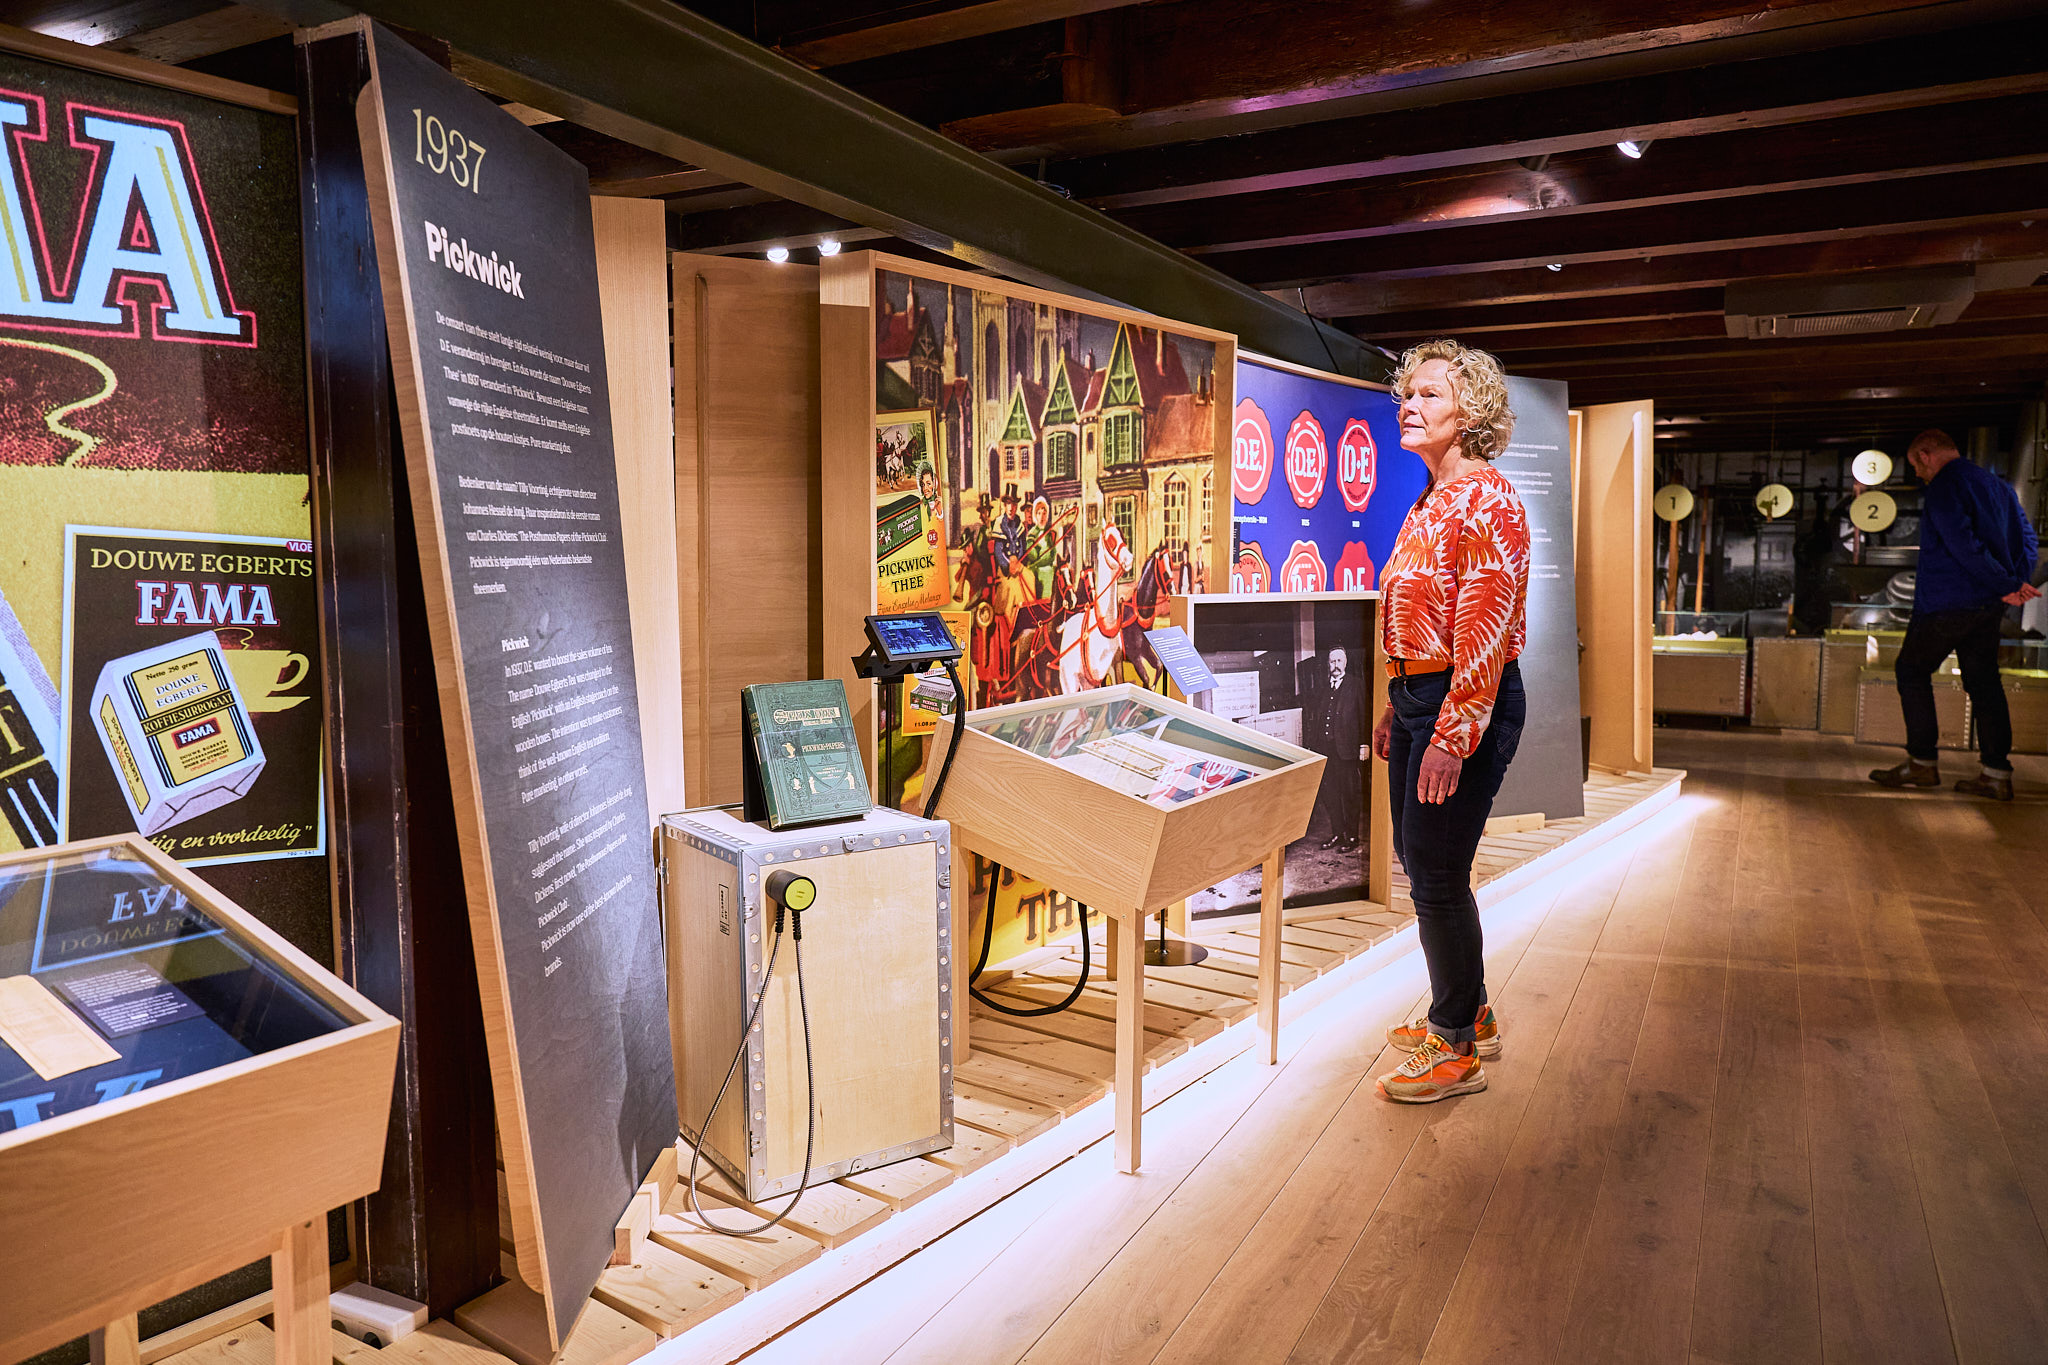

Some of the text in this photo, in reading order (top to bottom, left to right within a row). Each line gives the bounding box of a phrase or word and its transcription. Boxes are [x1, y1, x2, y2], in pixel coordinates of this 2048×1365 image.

[413, 109, 486, 194] 1937
[425, 220, 525, 300] Pickwick
[446, 317, 465, 331] omzet
[500, 334, 514, 349] lange
[523, 343, 539, 356] relatief
[539, 349, 554, 363] weinig
[451, 345, 486, 365] verandering
[490, 355, 513, 371] brengen.
[529, 369, 543, 380] wordt
[561, 377, 576, 389] 'Douwe
[576, 381, 592, 394] Egberts
[480, 379, 507, 393] veranderd
[536, 392, 553, 405] Bewust
[561, 398, 577, 411] Engelse
[447, 396, 473, 412] vanwege
[493, 404, 513, 419] Engelse
[513, 410, 541, 424] theetraditie.
[575, 424, 591, 436] Engelse
[451, 423, 480, 437] postkoets
[495, 430, 513, 443] houten
[513, 433, 531, 447] kistjes.
[541, 440, 563, 454] marketing
[1867, 462, 1877, 474] 3
[459, 475, 486, 489] Bedenker
[528, 483, 549, 497] Voorting,
[549, 486, 572, 498] echtgenote
[580, 489, 597, 499] directeur
[1670, 496, 1676, 510] 1
[1868, 504, 1879, 519] 2
[91, 548, 312, 577] DOUWE EGBERTS
[878, 555, 935, 578] PICKWICK
[474, 582, 507, 594] theemerken.
[891, 575, 924, 592] THEE
[135, 580, 280, 627] FAMA
[502, 636, 530, 651] Pickwick
[145, 660, 199, 681] Netto 250 gram
[511, 662, 525, 676] 1937,
[534, 656, 552, 670] wanted
[556, 653, 570, 665] boost
[154, 673, 201, 696] DOUWE
[154, 683, 209, 709] EGBERTS
[520, 688, 534, 700] name
[533, 681, 551, 695] 'Douwe
[551, 676, 569, 692] Egberts
[142, 691, 235, 734] KOFFIESURROGAAT
[512, 712, 532, 729] English
[571, 695, 586, 709] English
[178, 723, 216, 745] FAMA
[515, 721, 581, 753] wooden boxes. intention
[519, 740, 587, 778] think well-known English
[533, 777, 558, 798] marketing,
[574, 762, 589, 778] words.
[180, 836, 205, 849] en
[539, 827, 560, 846] Voorting,
[532, 854, 556, 878] suggested
[538, 906, 558, 928] Pickwick
[541, 883, 617, 952] Pickwick best-known
[545, 957, 563, 977] brands.
